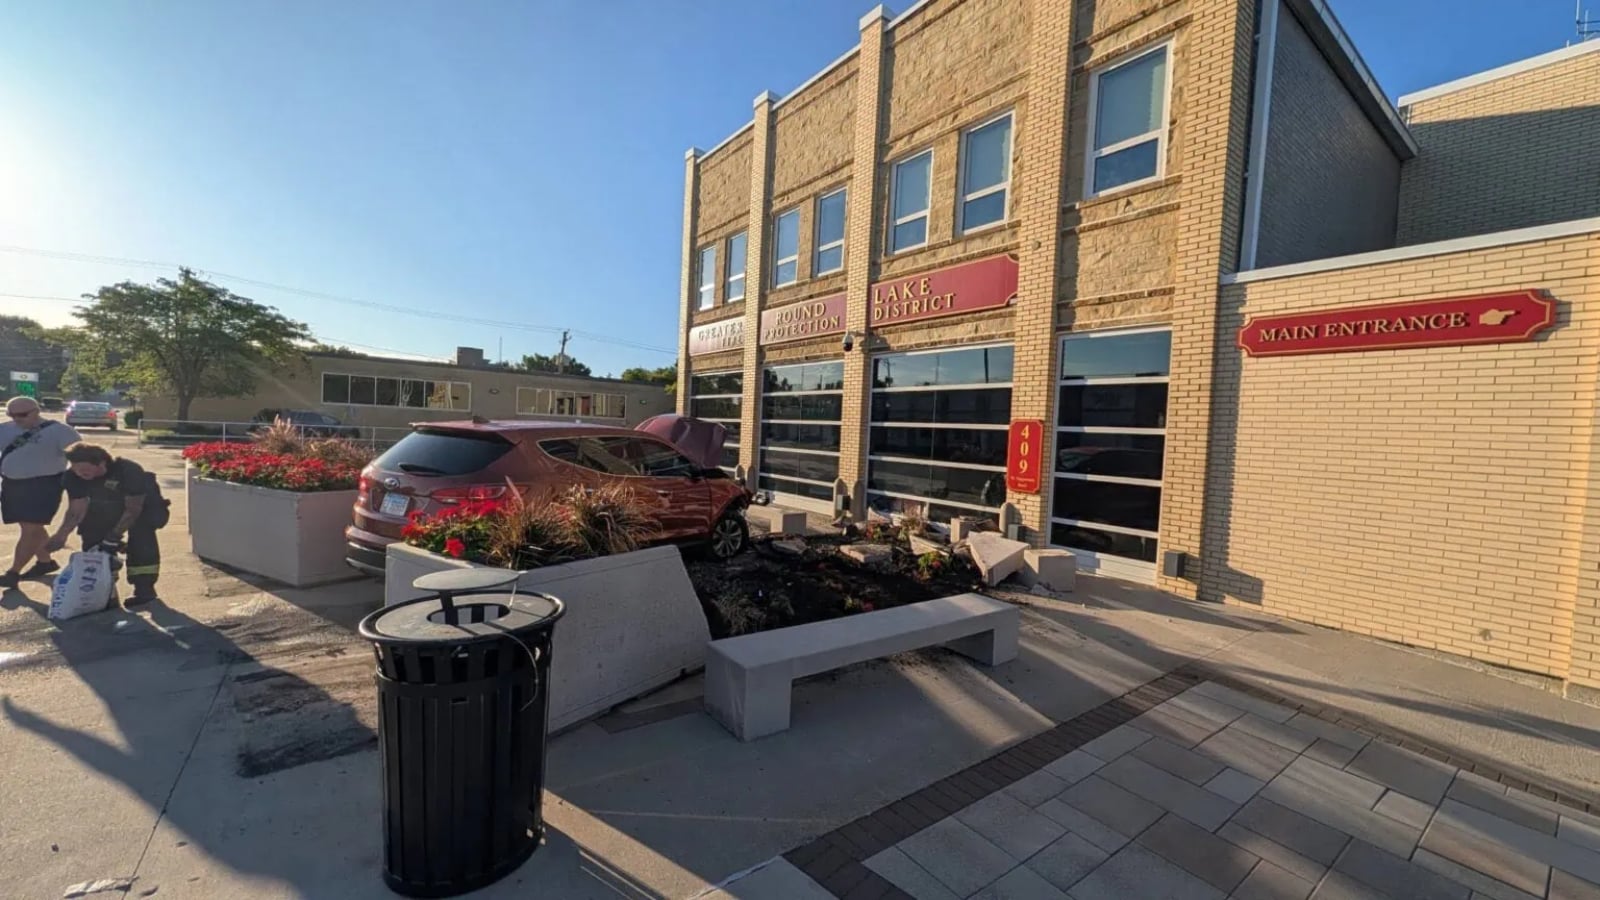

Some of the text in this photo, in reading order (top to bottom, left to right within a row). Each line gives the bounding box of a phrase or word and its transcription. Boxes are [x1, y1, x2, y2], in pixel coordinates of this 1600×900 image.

[698, 277, 932, 341] GREATER ROUND LAKE
[764, 315, 840, 341] PROTECTION
[873, 293, 955, 321] DISTRICT
[1258, 312, 1468, 343] MAIN ENTRANCE
[1018, 424, 1030, 474] 409
